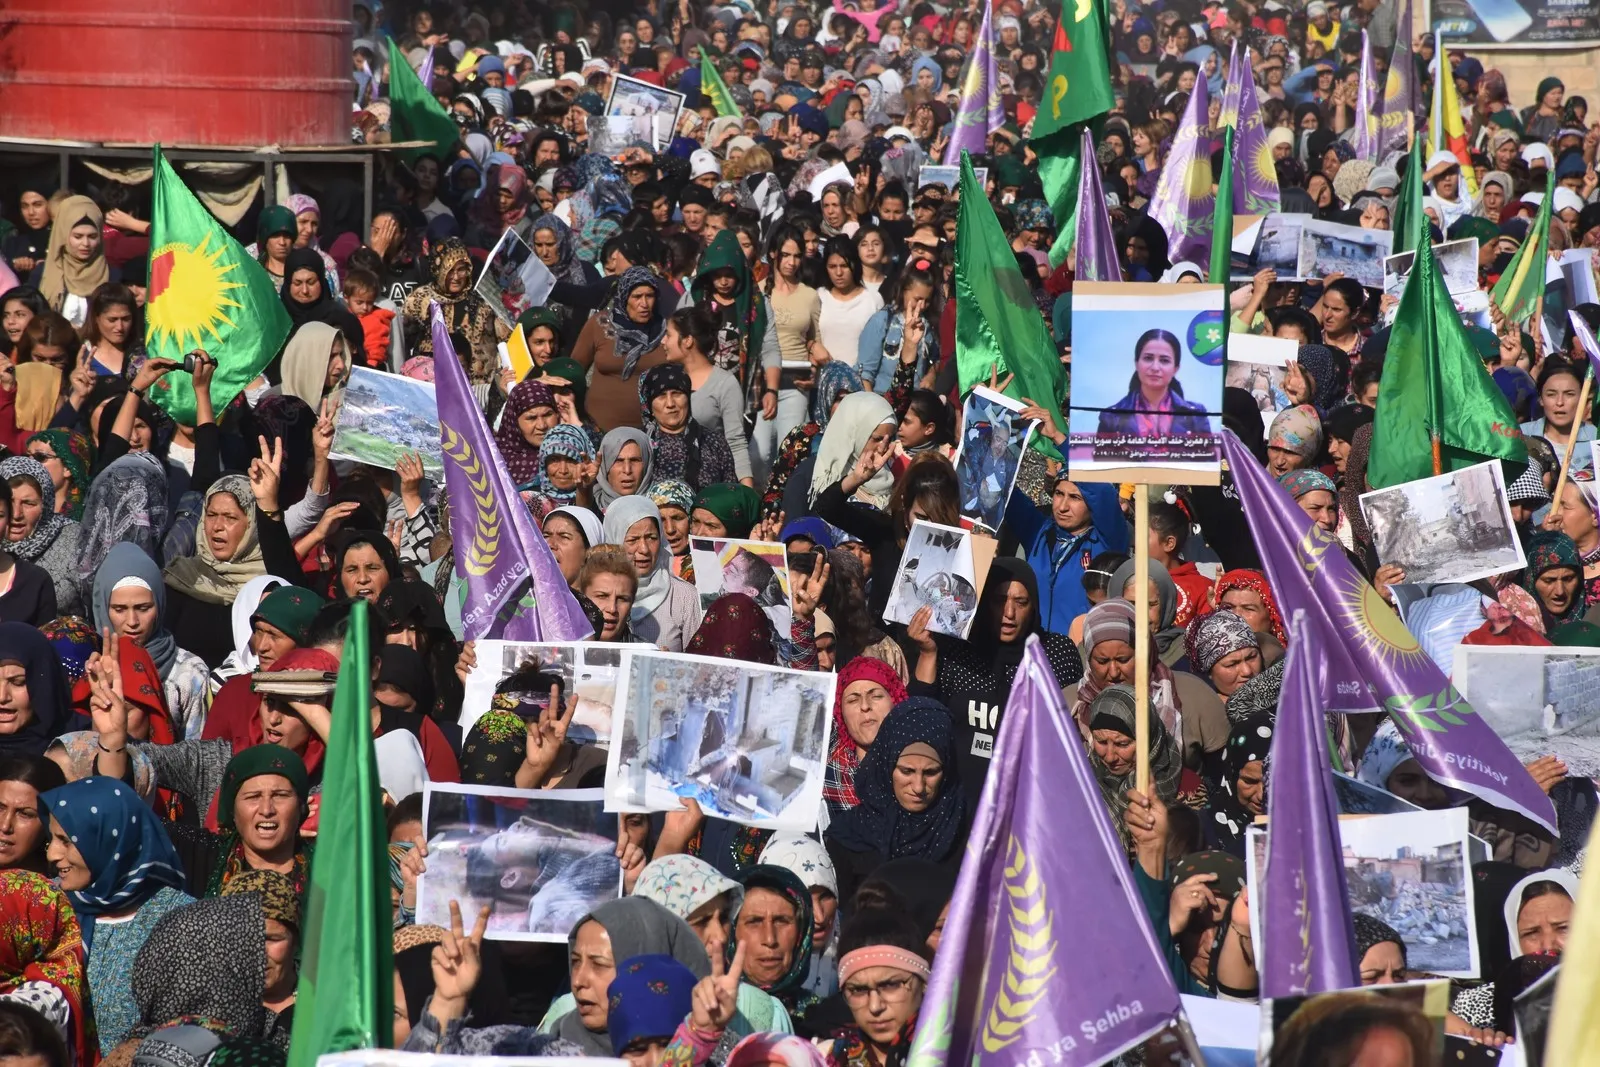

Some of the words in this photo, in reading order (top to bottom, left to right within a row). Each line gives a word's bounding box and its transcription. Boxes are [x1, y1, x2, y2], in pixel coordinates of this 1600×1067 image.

[1439, 20, 1469, 32] MTN
[1094, 436, 1112, 447] سوريا
[1168, 435, 1184, 444] خلف
[483, 575, 509, 607] Azad
[506, 561, 526, 580] ya
[1047, 1034, 1077, 1063] ya
[1079, 999, 1144, 1044] Şehba
